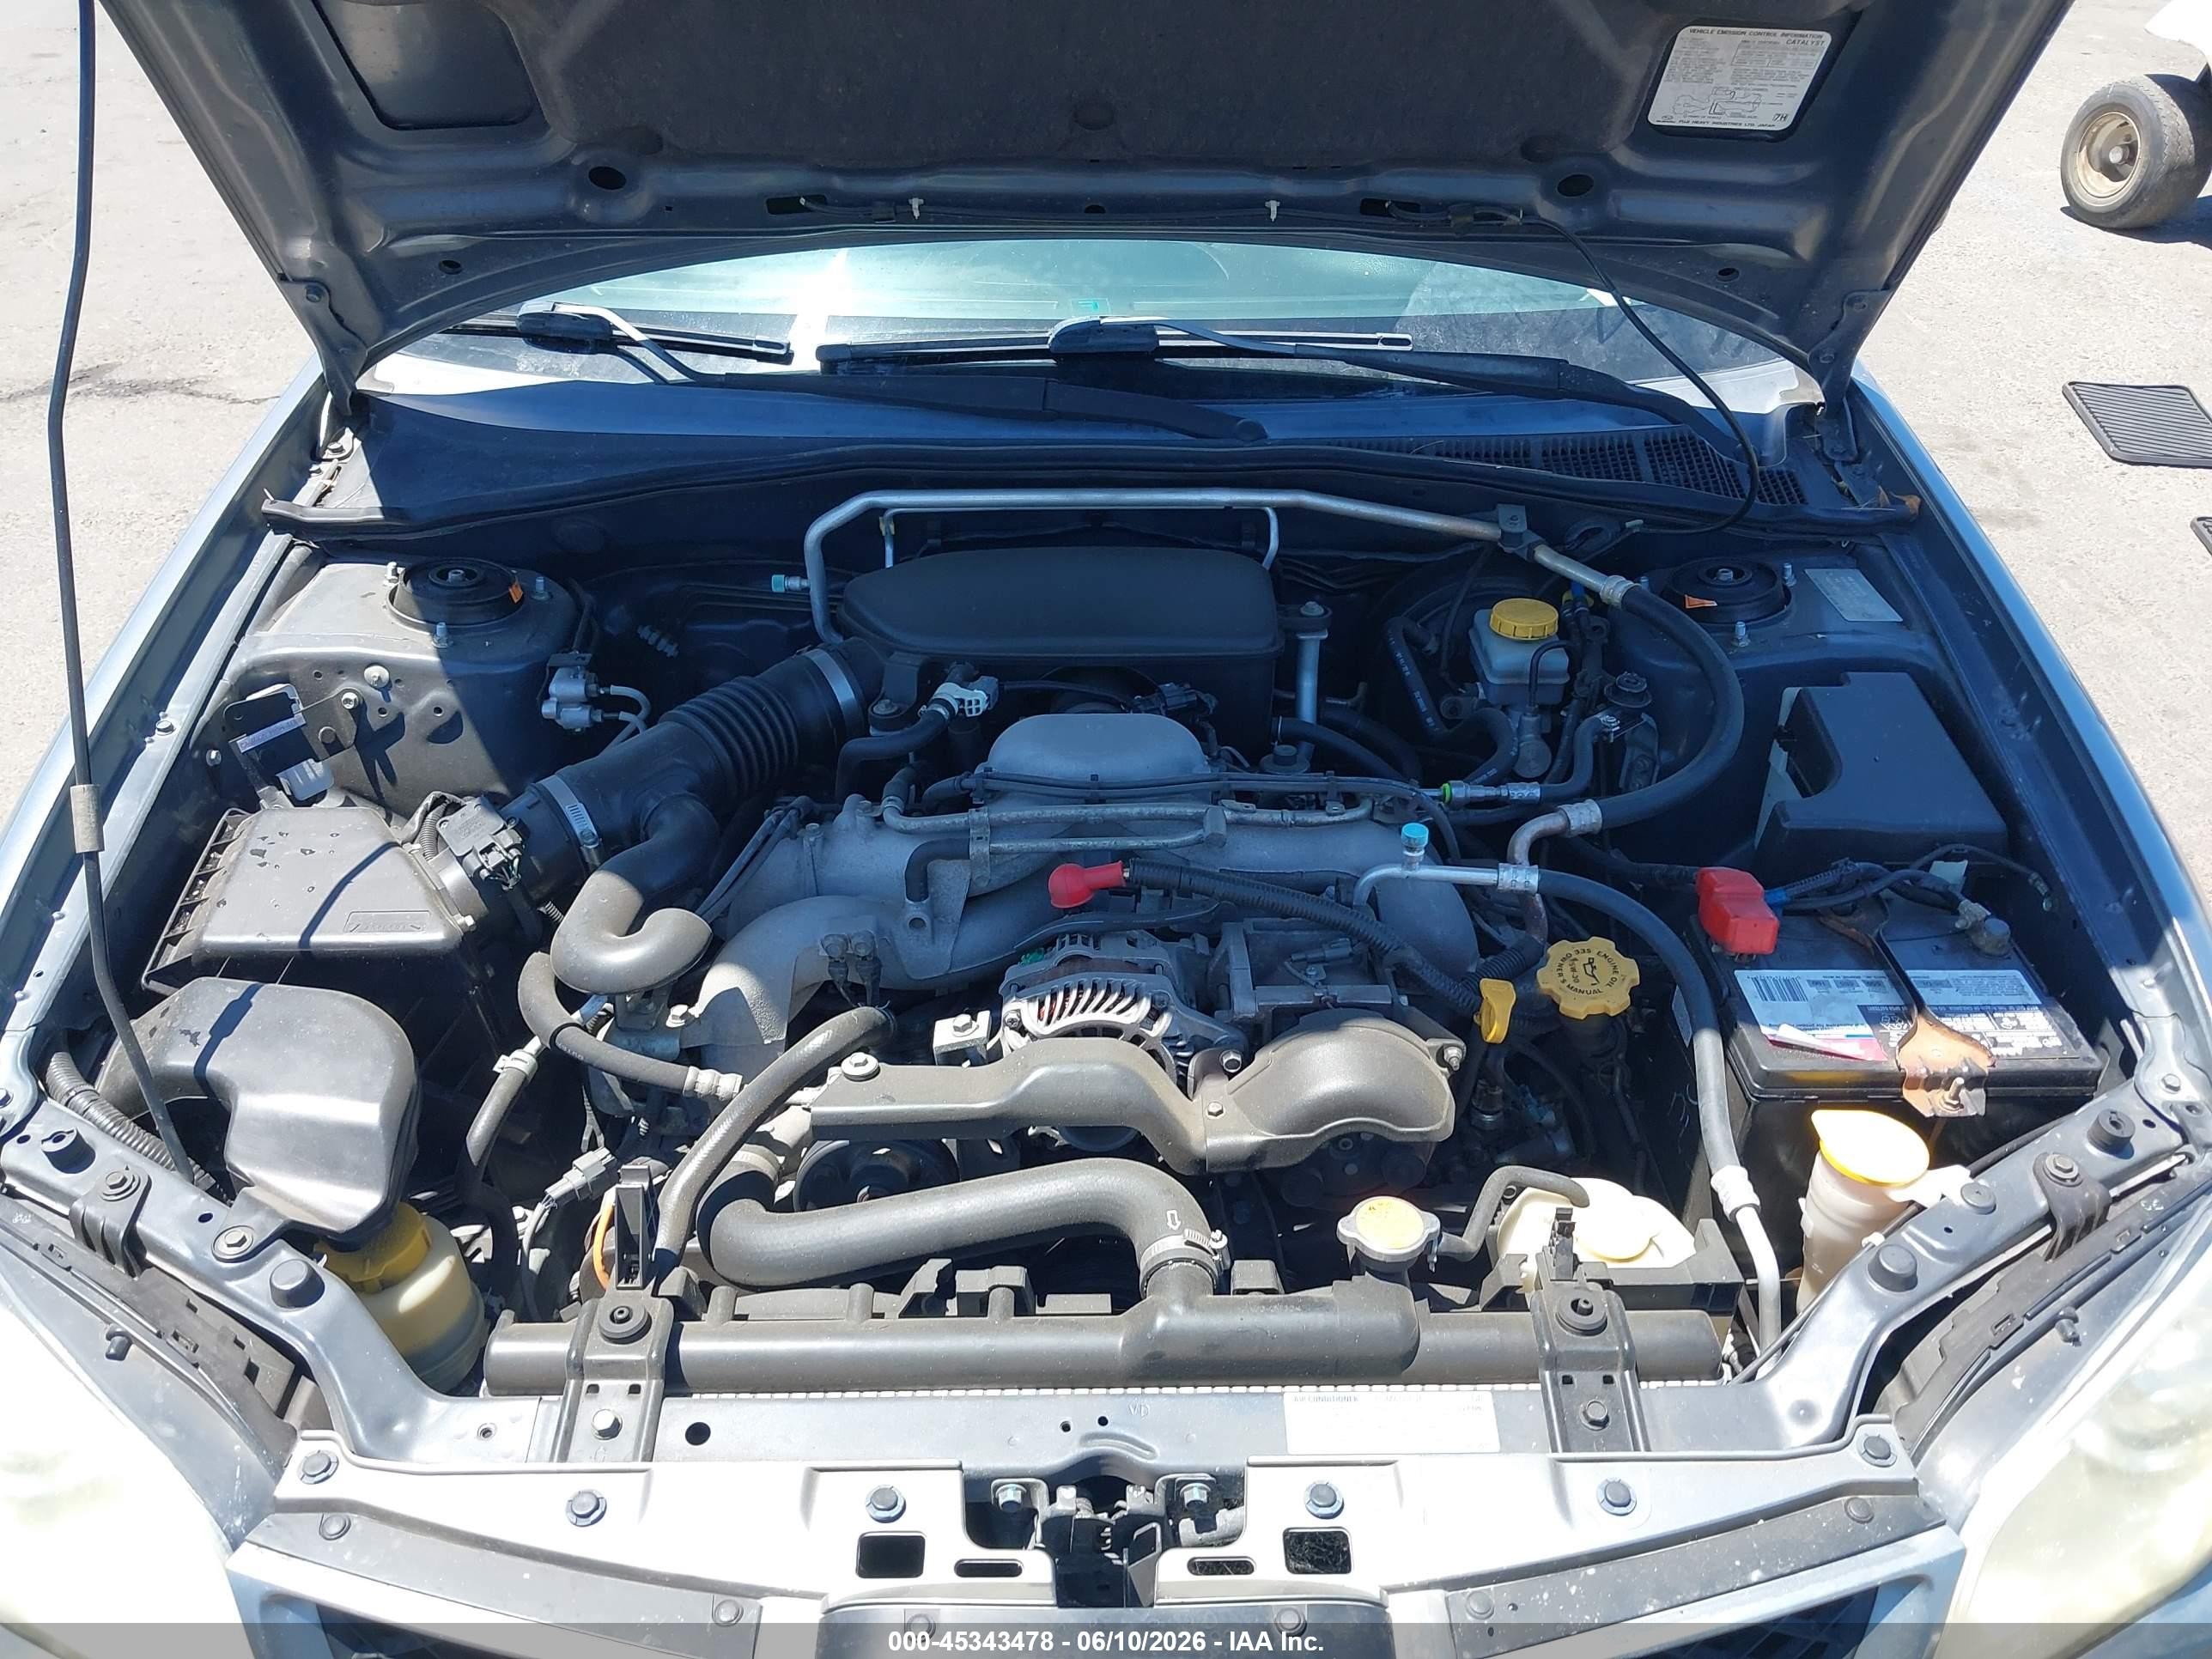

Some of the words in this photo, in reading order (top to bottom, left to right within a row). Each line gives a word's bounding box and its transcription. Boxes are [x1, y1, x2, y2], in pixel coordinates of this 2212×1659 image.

[1772, 113, 1789, 122] 7H
[1596, 951, 1620, 975] ENGINE
[1569, 963, 1580, 983] 5W-30
[1605, 975, 1619, 988] OIL
[1566, 984, 1604, 995] MANUAL
